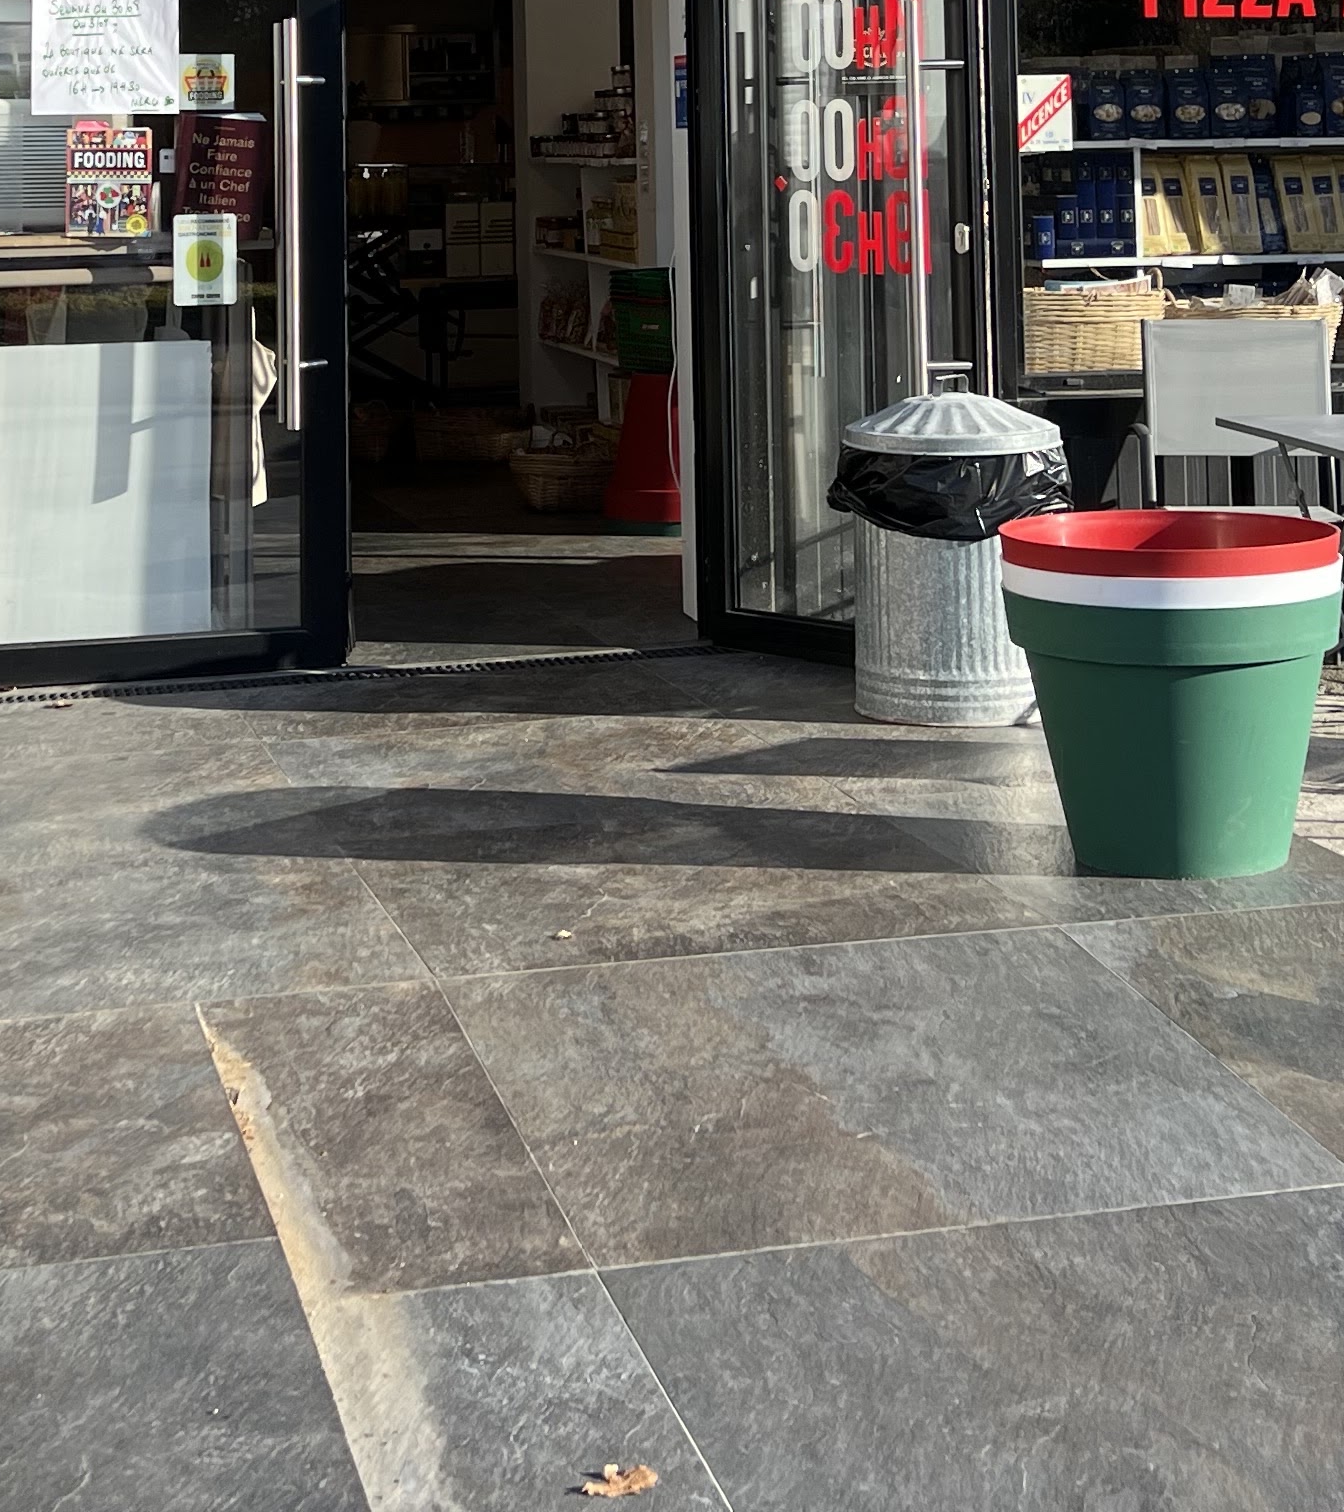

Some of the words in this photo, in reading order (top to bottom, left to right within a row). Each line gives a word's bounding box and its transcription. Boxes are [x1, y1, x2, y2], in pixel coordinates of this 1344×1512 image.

[1020, 81, 1068, 144] LICENCE
[192, 133, 210, 145] Ne
[213, 135, 255, 148] Jamais
[207, 149, 237, 162] Faire
[189, 163, 253, 178] Confiance
[200, 181, 215, 190] un
[219, 179, 250, 192] Chef
[199, 193, 236, 206] Italien
